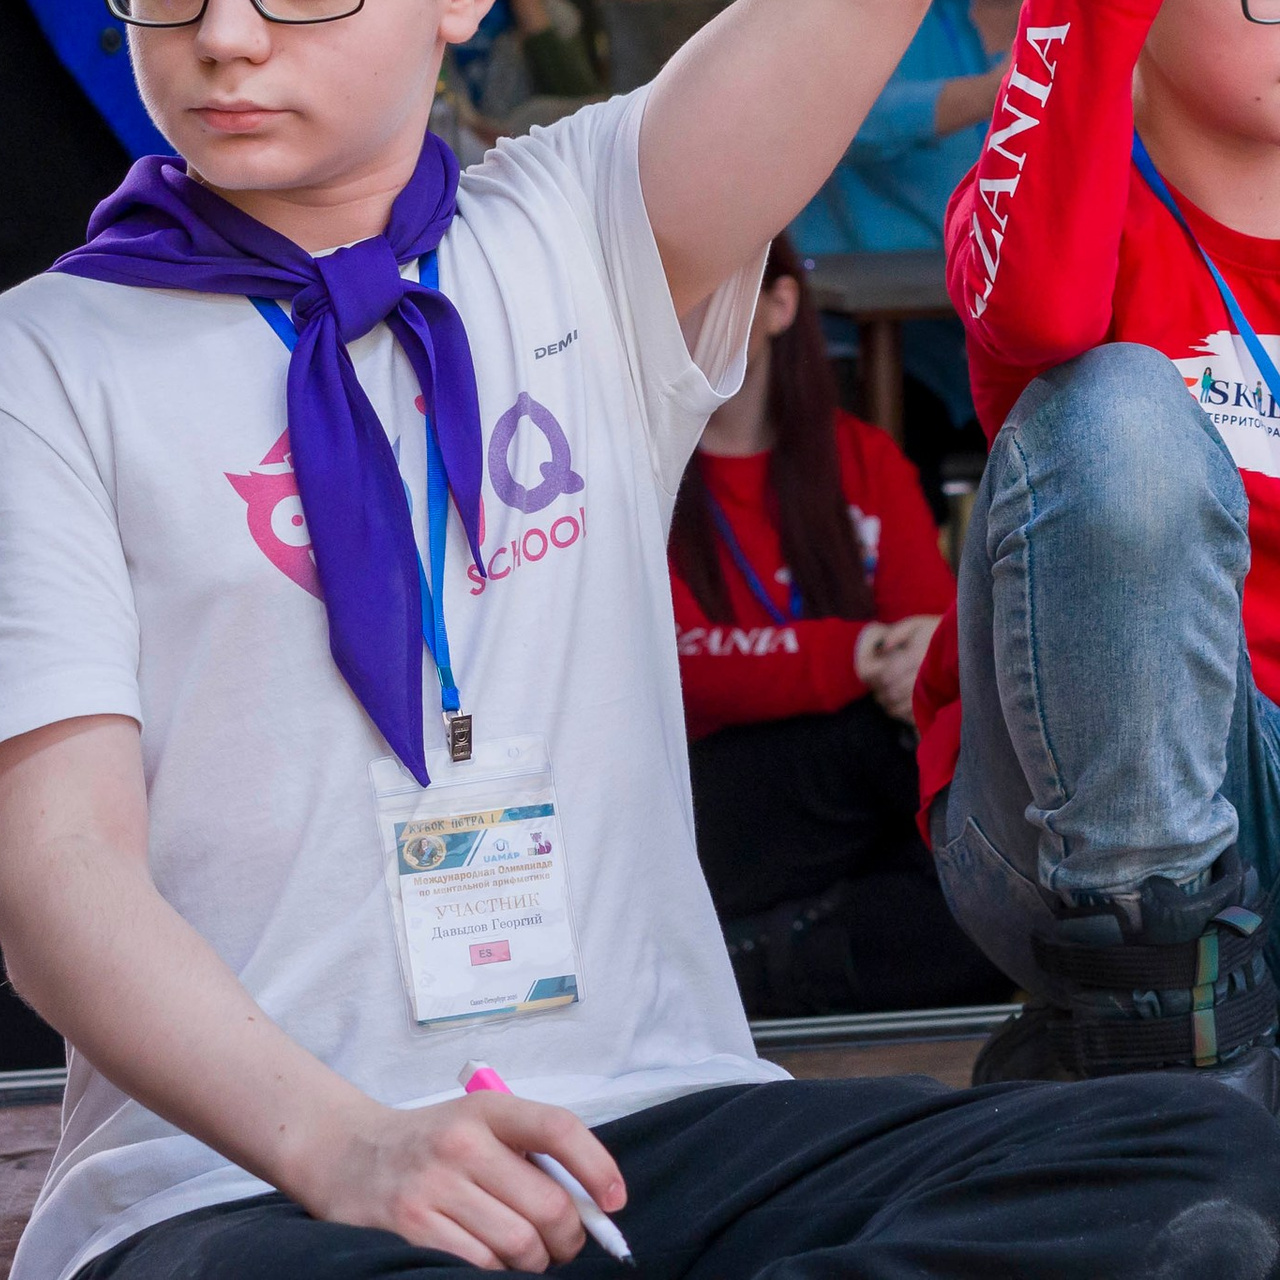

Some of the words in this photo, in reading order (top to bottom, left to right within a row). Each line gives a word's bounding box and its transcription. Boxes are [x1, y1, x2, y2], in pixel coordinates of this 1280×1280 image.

[534, 329, 578, 360] DEMI
[413, 868, 496, 887] Международная
[498, 860, 553, 874] Олимпиада
[419, 889, 431, 897] по
[433, 879, 490, 895] ментальной
[435, 892, 540, 920] УЧАСТНИК
[431, 923, 488, 941] Давыдов
[492, 913, 543, 931] Георгий
